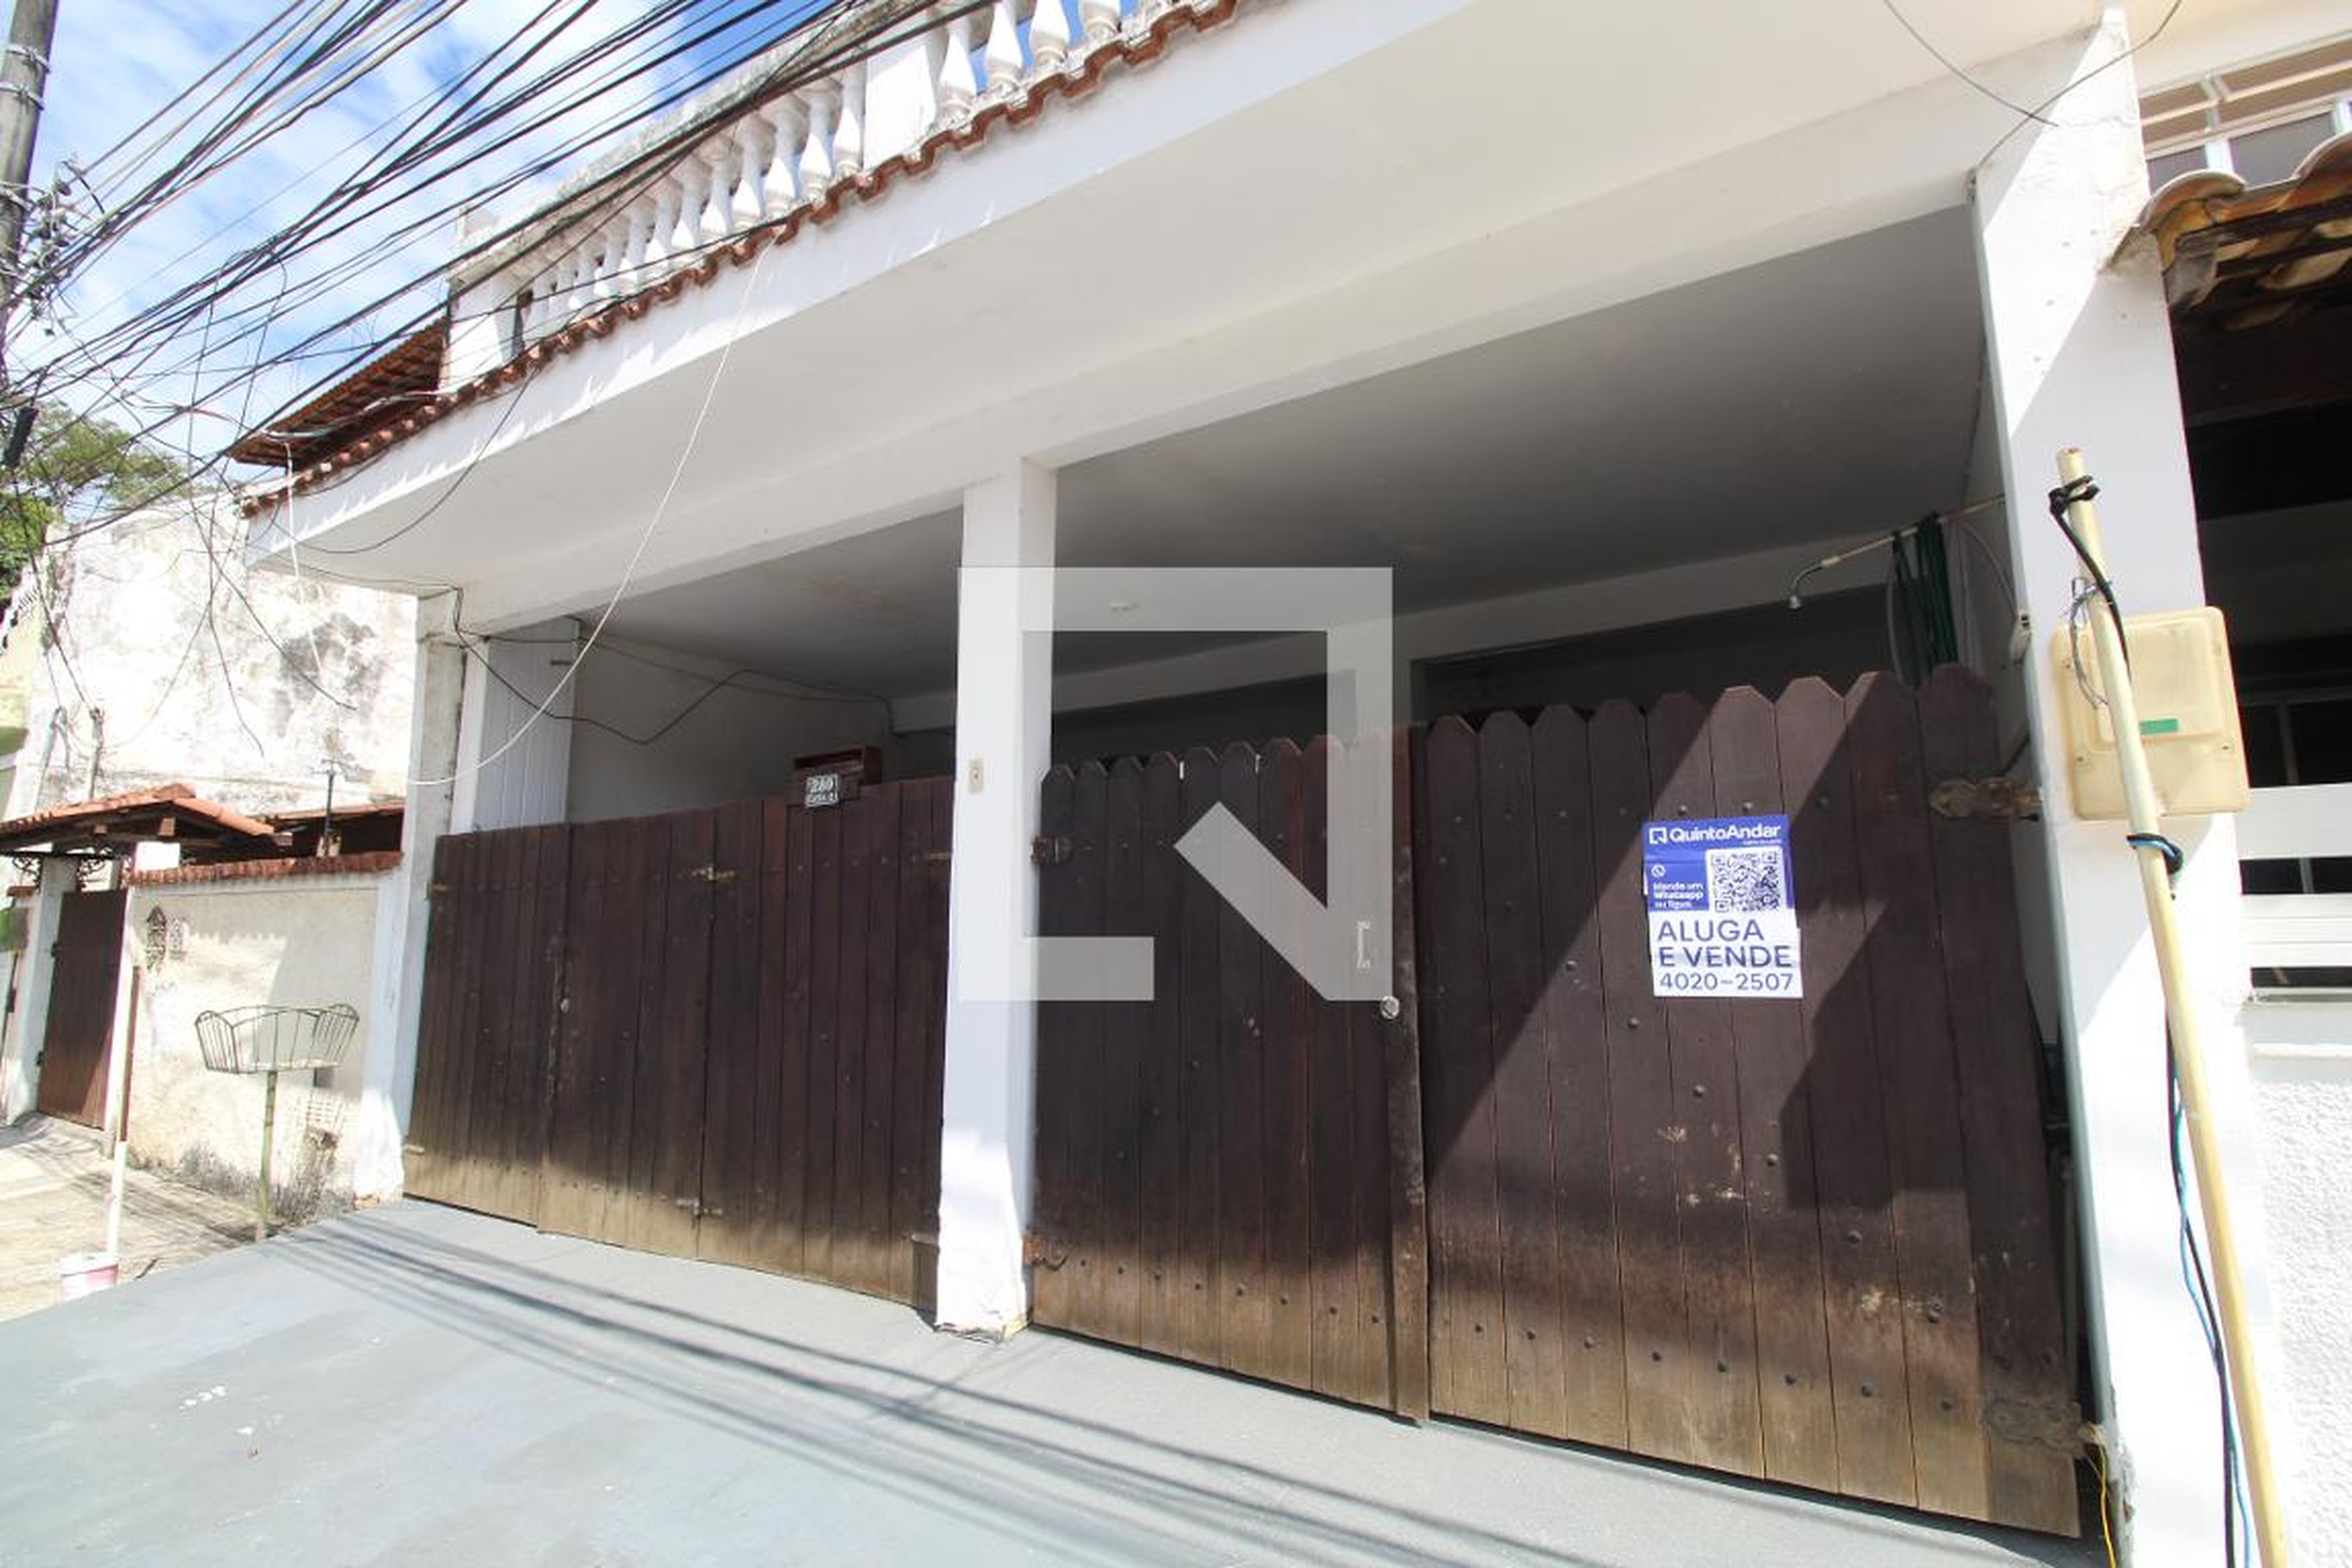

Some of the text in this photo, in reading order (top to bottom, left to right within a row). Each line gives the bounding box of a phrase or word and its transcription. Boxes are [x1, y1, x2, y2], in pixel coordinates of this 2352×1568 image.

[1669, 824, 1781, 842] QuintoAndar
[1657, 919, 1764, 941] ALUGA
[1659, 945, 1792, 968] E VENDE
[1660, 972, 1793, 992] 4020-2507
